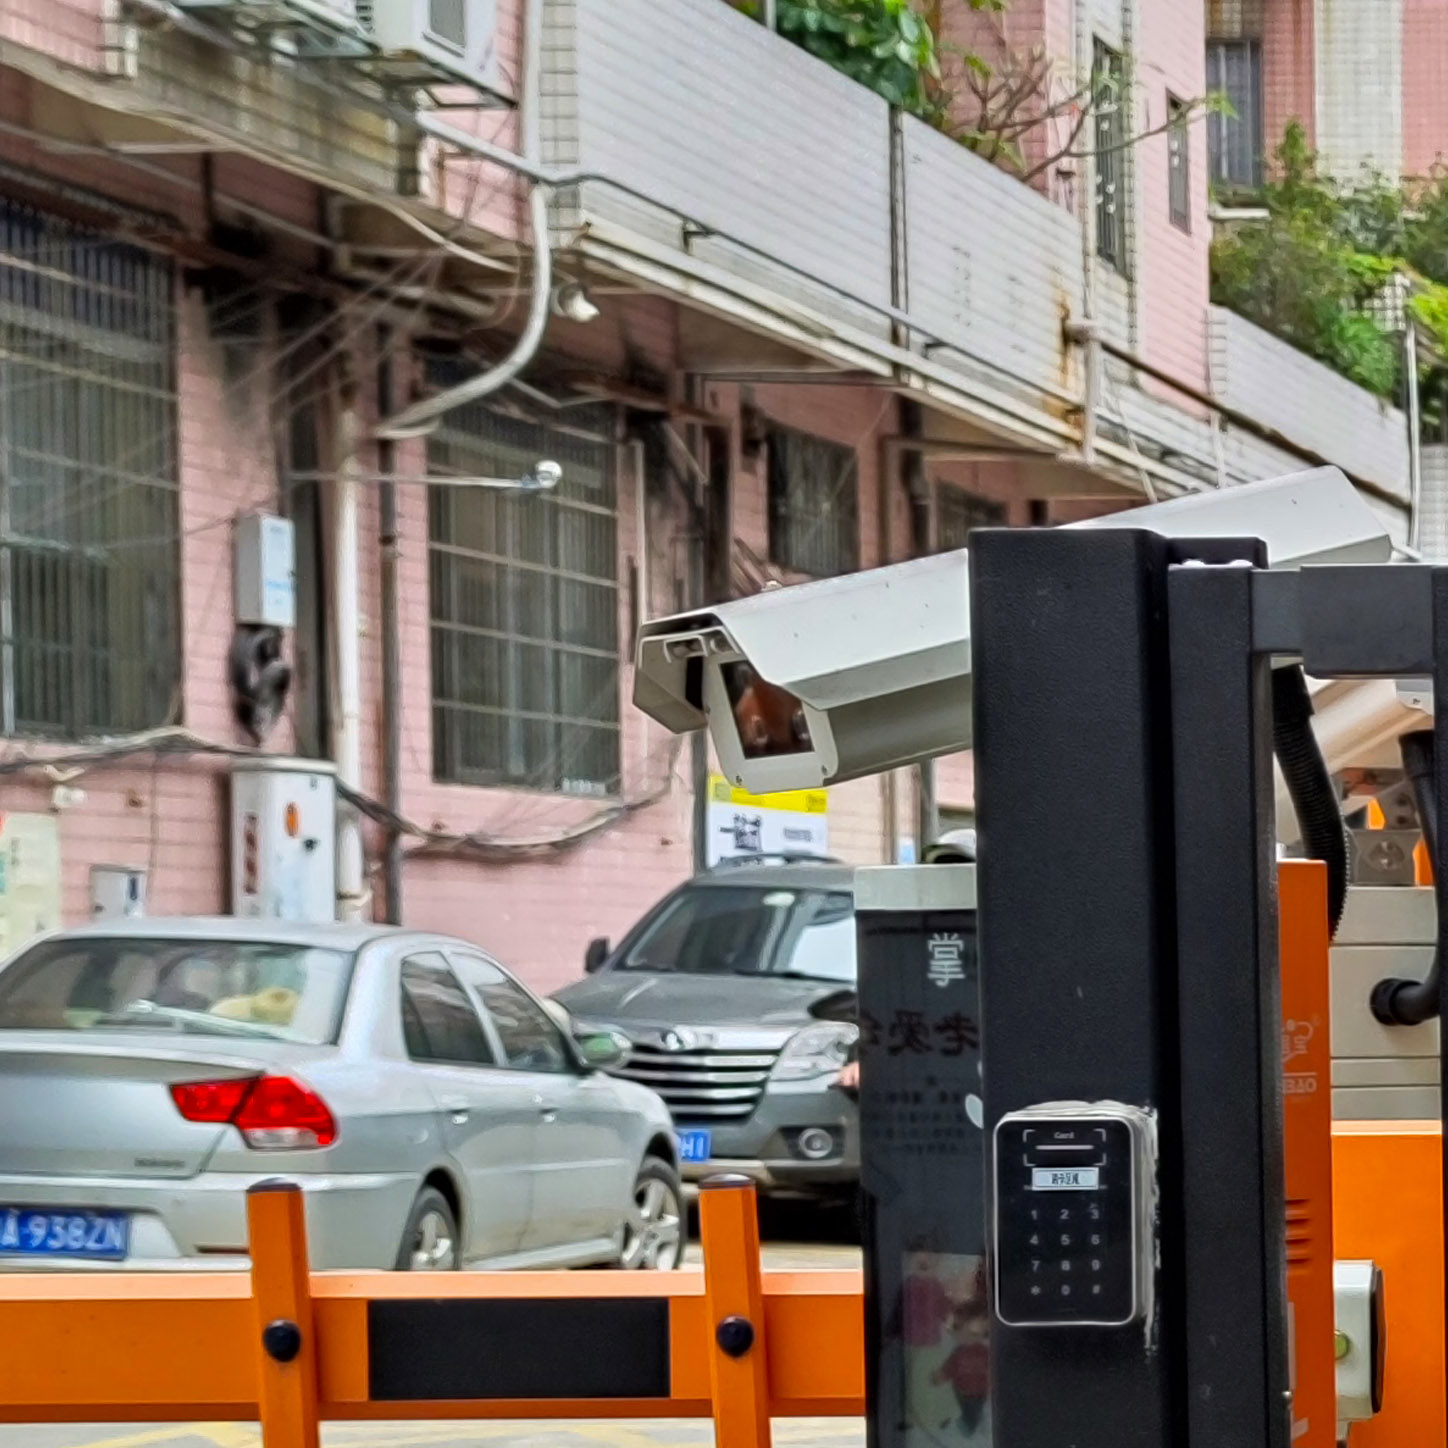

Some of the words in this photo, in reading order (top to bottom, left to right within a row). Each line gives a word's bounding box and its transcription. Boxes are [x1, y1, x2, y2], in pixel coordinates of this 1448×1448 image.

[927, 932, 966, 988] 掌
[1032, 1210, 1037, 1220] 1
[1060, 1210, 1069, 1219] 2
[1091, 1209, 1099, 1219] 3
[1030, 1235, 1039, 1244] 4
[1061, 1234, 1070, 1244] 5
[1032, 1261, 1040, 1270] 7
